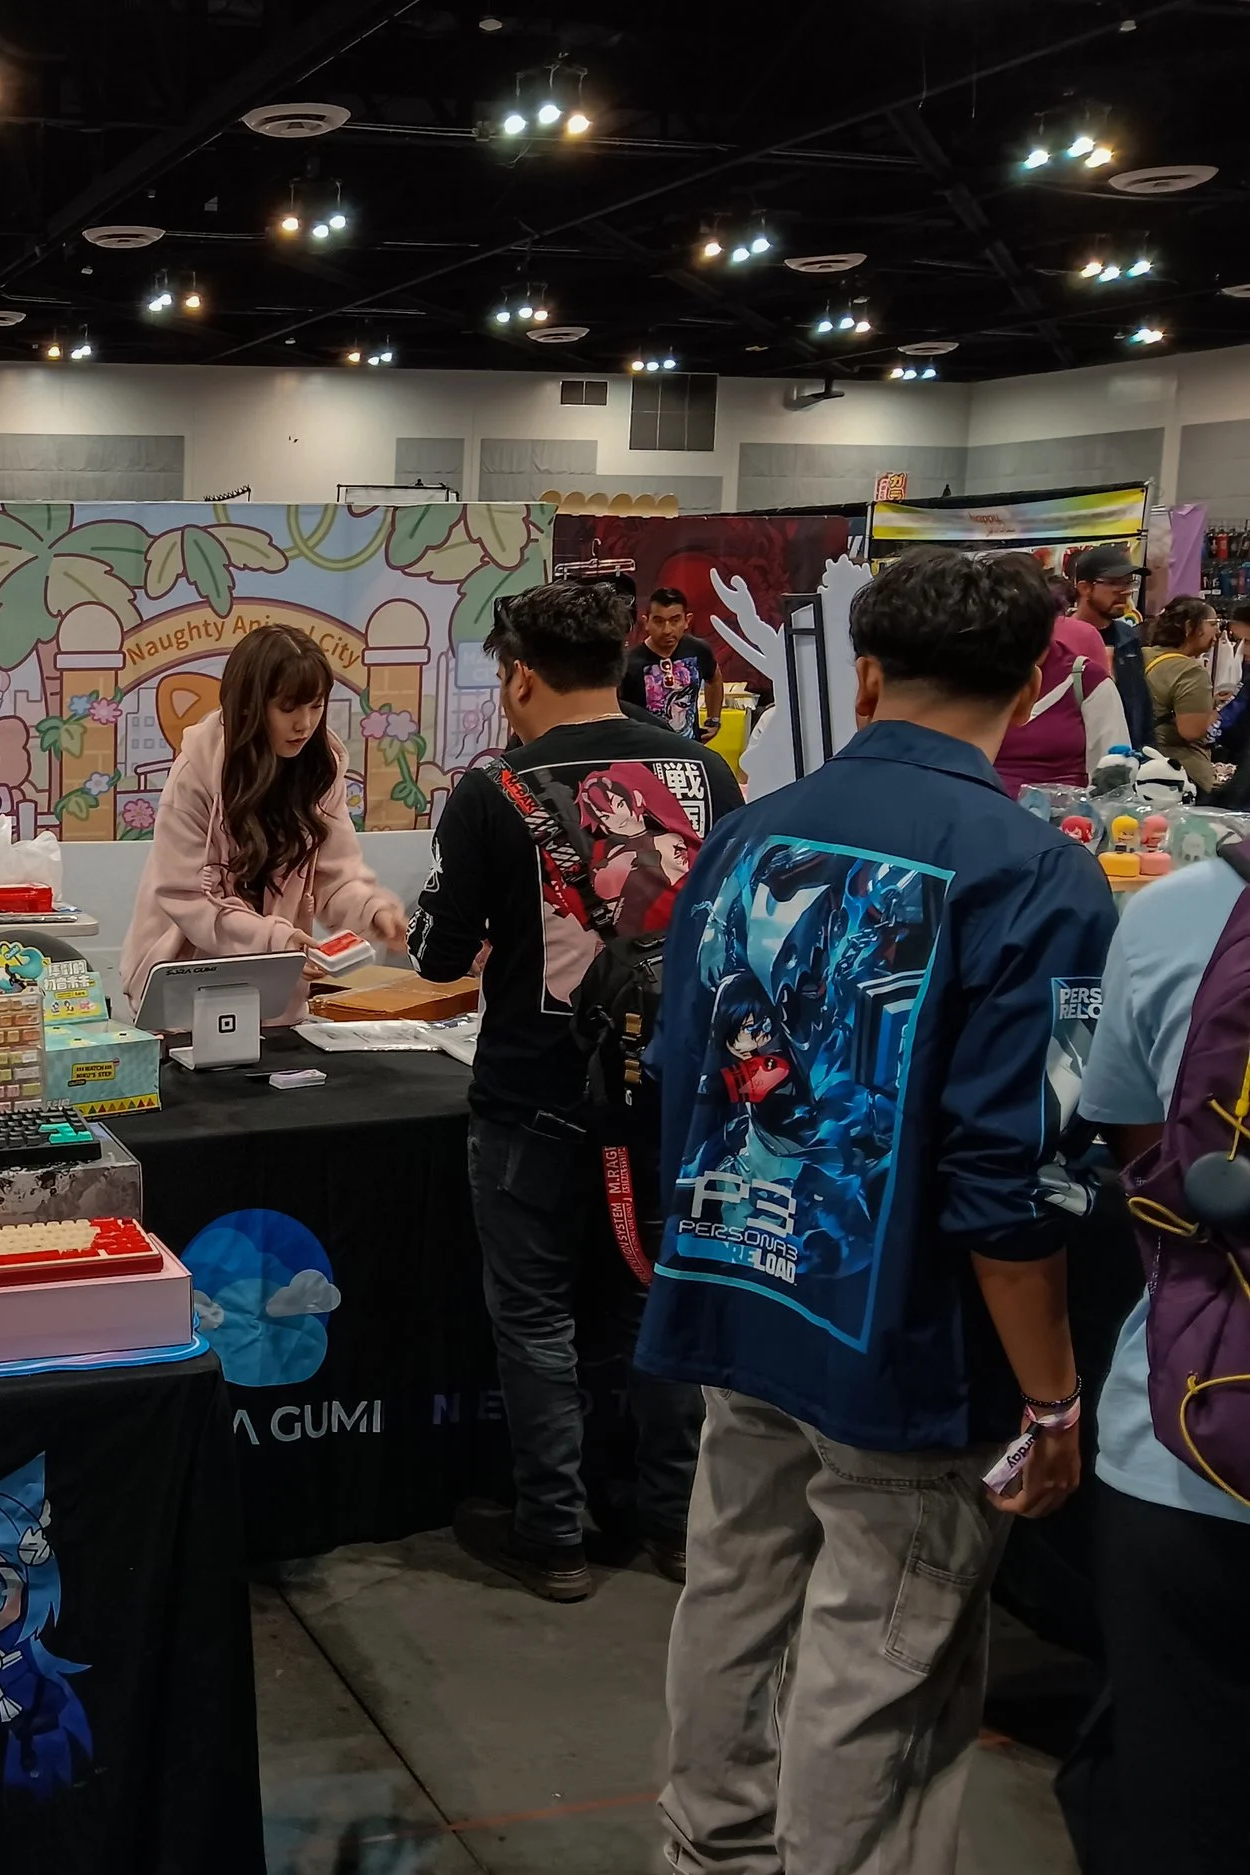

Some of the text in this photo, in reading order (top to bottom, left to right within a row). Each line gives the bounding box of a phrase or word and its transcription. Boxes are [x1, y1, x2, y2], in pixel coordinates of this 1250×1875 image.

[126, 619, 226, 666] Naughty
[318, 631, 362, 669] City
[1059, 987, 1102, 1004] PERS
[1059, 1003, 1103, 1020] RELO
[612, 1202, 628, 1243] SYSTEM
[676, 1170, 796, 1239] P3
[270, 1399, 383, 1443] GUMI
[1006, 1436, 1035, 1469] urday
